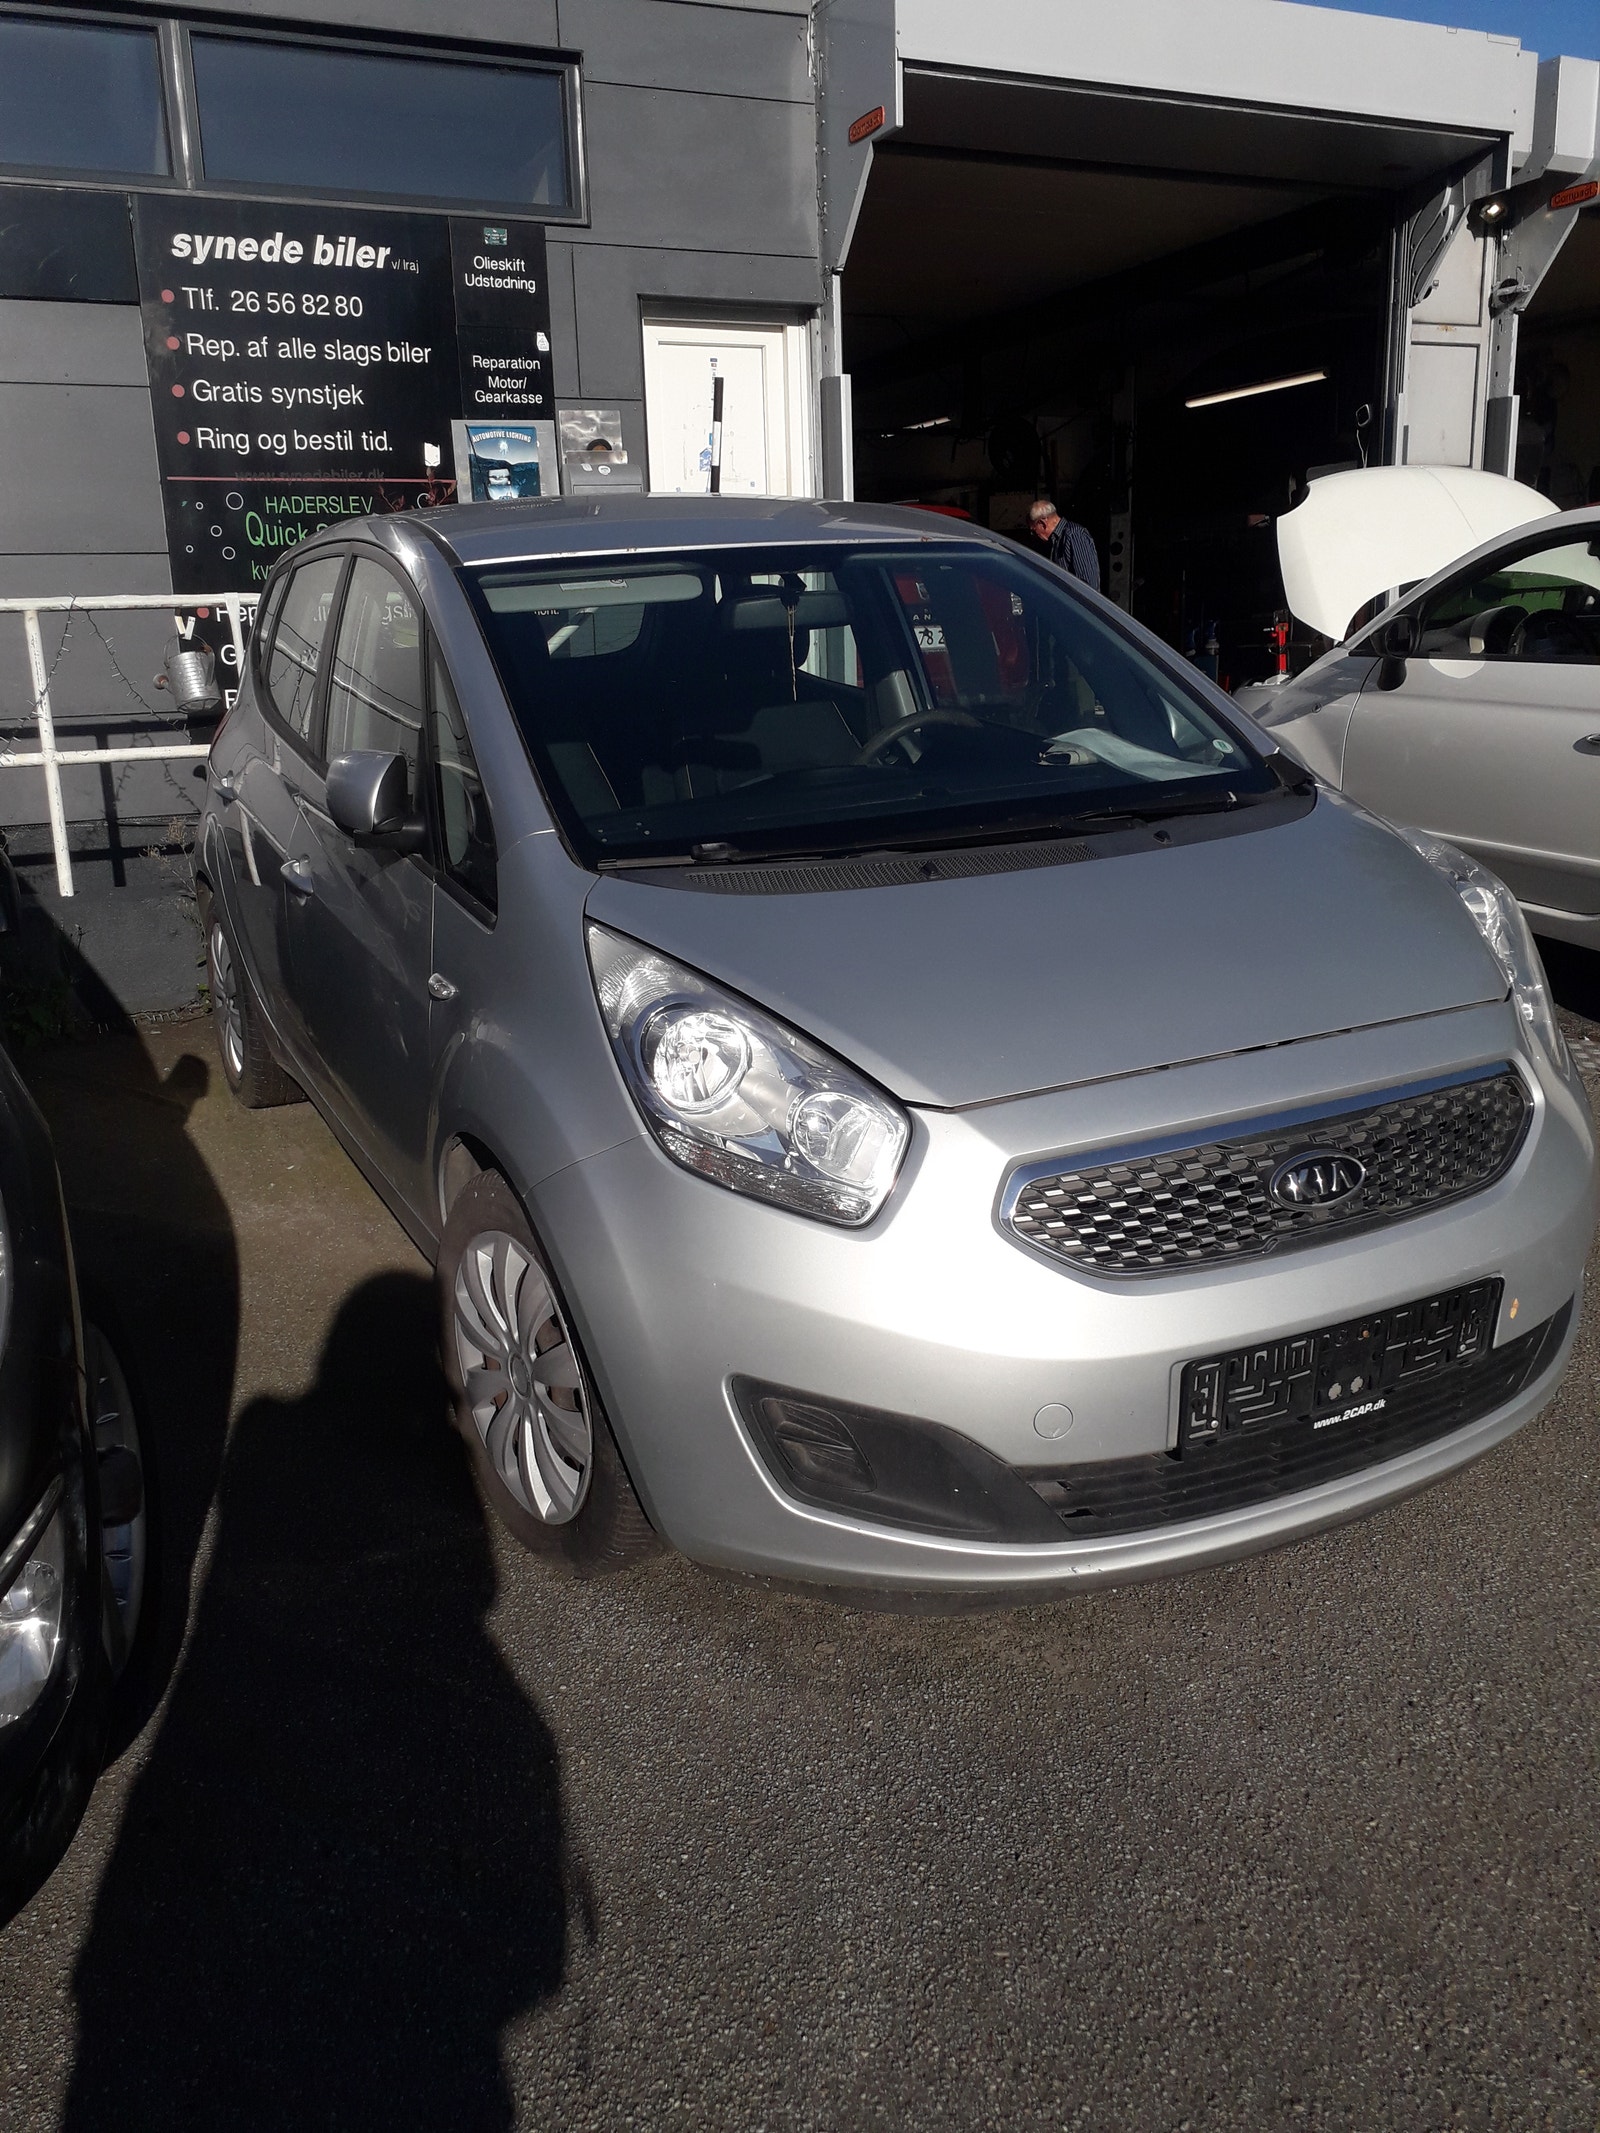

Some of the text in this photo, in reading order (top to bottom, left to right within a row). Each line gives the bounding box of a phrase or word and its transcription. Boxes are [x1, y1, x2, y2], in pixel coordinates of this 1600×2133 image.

[171, 232, 304, 265] synede
[313, 234, 391, 269] biler
[473, 255, 526, 272] Olieskift
[464, 273, 536, 293] Udstødning
[181, 286, 364, 318] Tlf. 26 56 82 80
[186, 332, 432, 367] Rep. af alle slags biler
[472, 354, 541, 372] Reparation
[192, 379, 365, 411] Gratis synstjek
[474, 389, 543, 404] Gearkasse
[488, 375, 528, 390] Motor/
[196, 427, 393, 456] Ring og bestil tid.
[472, 430, 532, 443] AUTOMOTIVE LIGHTING
[265, 496, 373, 514] HADERSLEV
[245, 511, 309, 547] Quick
[1286, 1160, 1356, 1201] KIA
[1313, 1398, 1387, 1430] www.2CAP.dk
